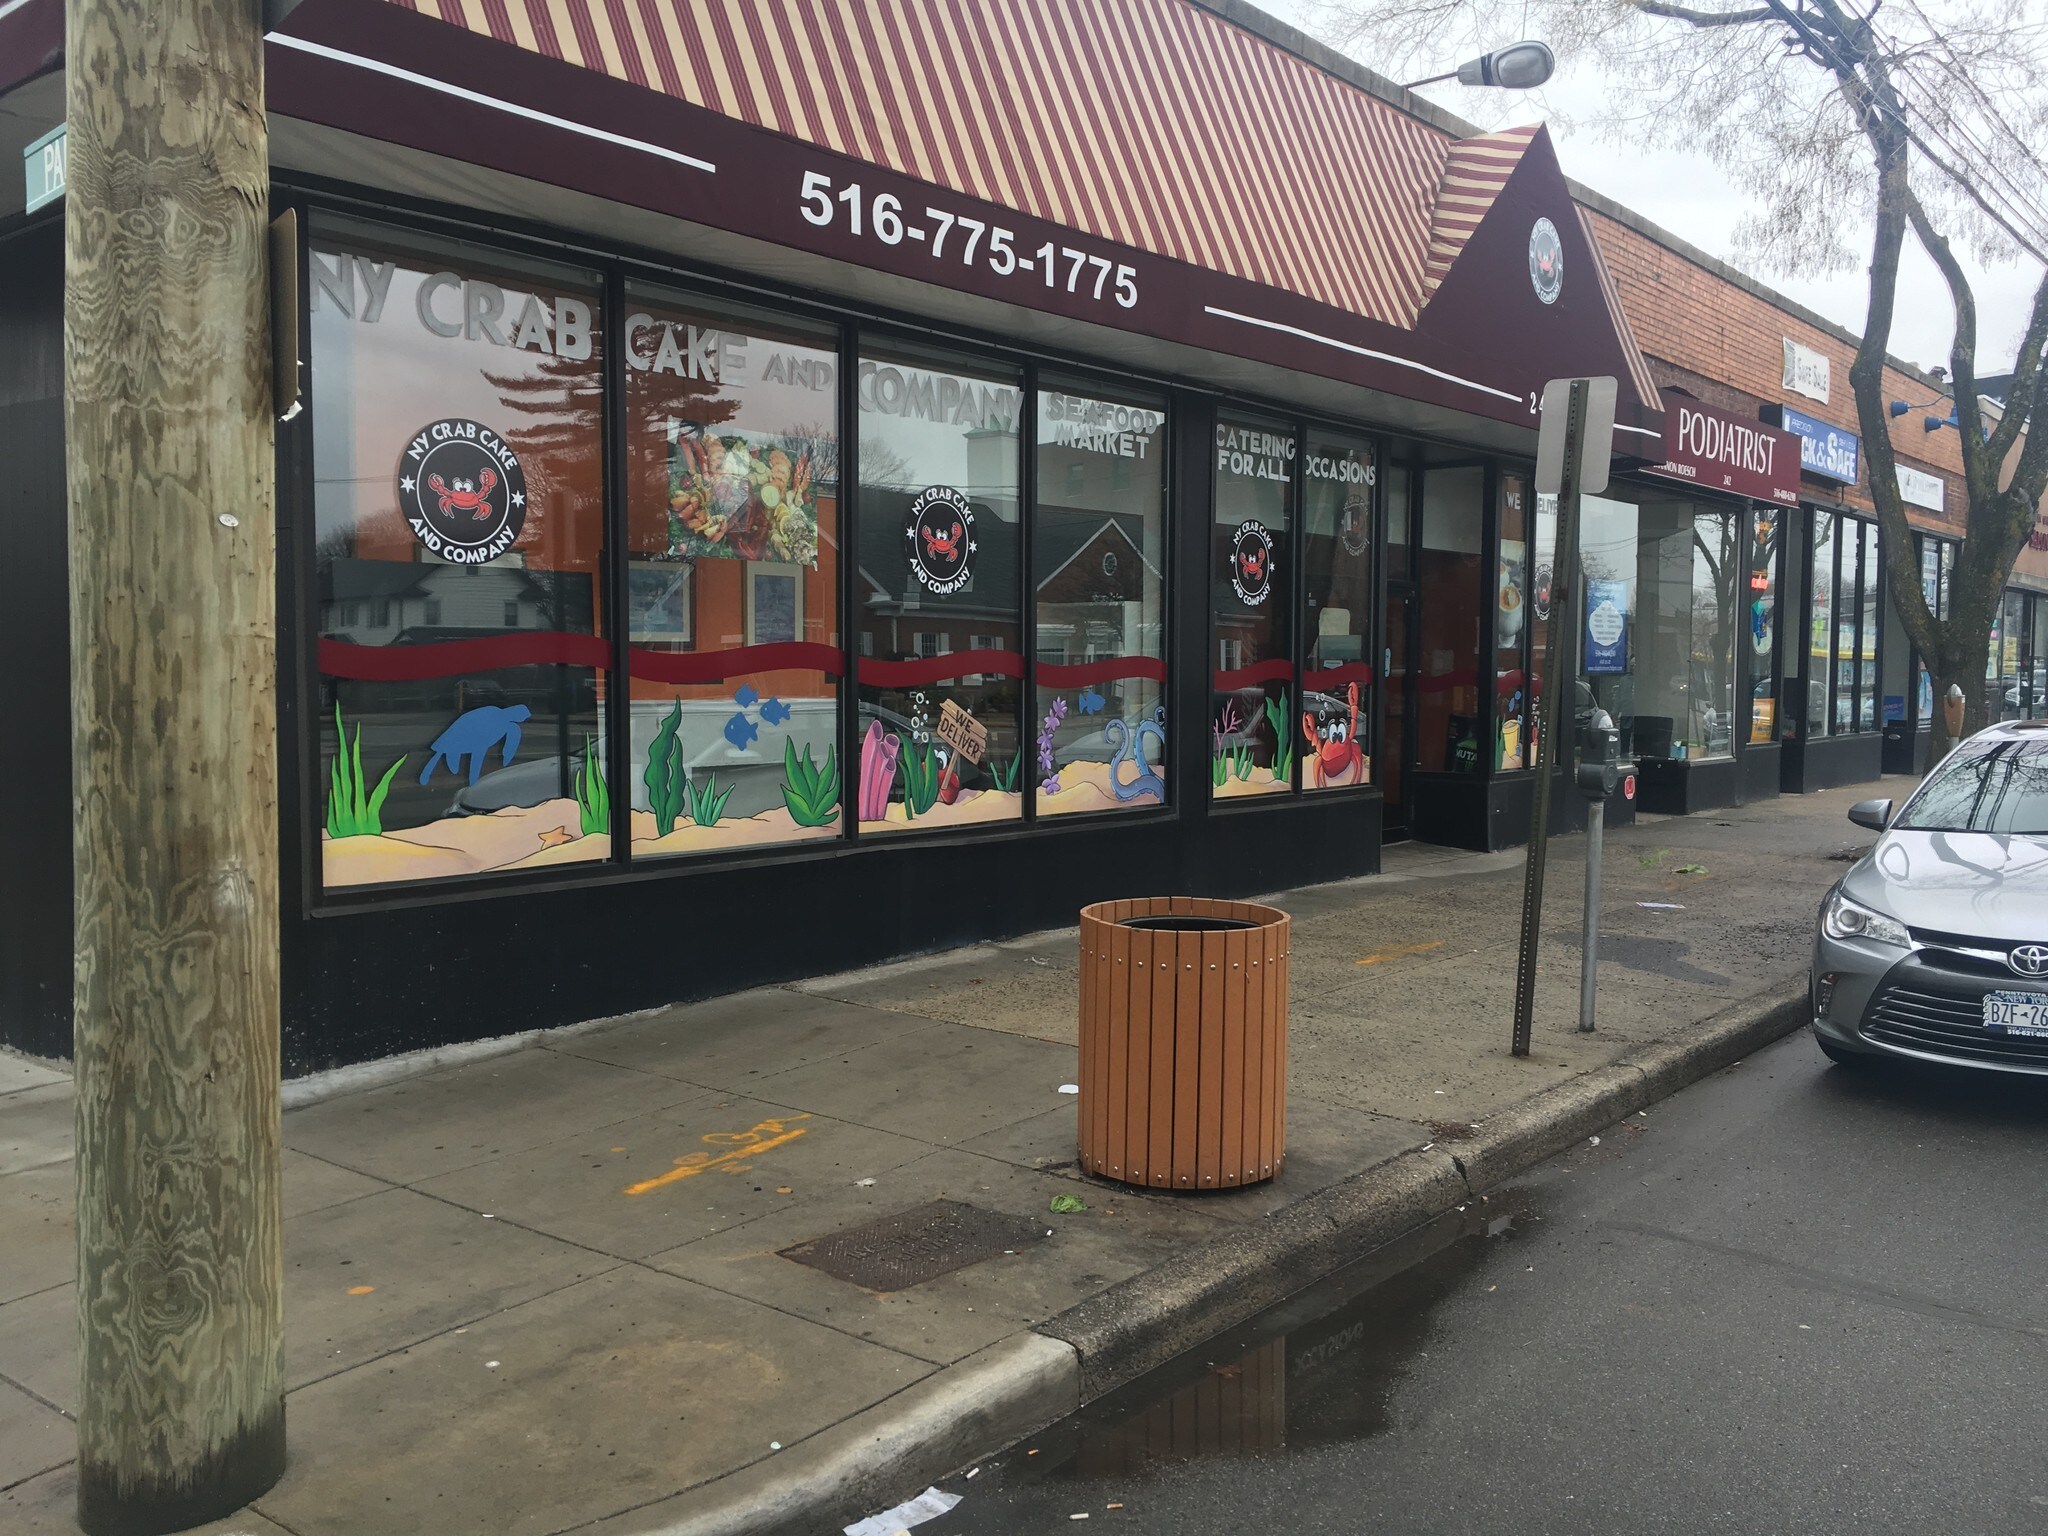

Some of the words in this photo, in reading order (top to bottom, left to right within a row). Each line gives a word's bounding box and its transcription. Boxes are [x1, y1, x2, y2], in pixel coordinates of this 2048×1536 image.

[44, 133, 66, 193] PA
[800, 170, 1138, 308] 516-775-1775
[309, 248, 396, 323] NY
[415, 271, 592, 361] CRAB
[625, 312, 749, 388] CAKE
[761, 352, 834, 392] AND
[858, 361, 1025, 430] COMPANY
[1045, 391, 1158, 435] SEAFOOD
[407, 432, 430, 461] NY
[431, 422, 476, 440] CRAB
[480, 430, 518, 471] CAKE
[1054, 423, 1150, 459] MARKET
[1216, 424, 1296, 461] CATERING
[1678, 407, 1776, 476] PODIATRIST
[1827, 432, 1856, 479] SAFE
[1218, 449, 1255, 477] FOR
[1256, 458, 1290, 482] ALL
[912, 495, 925, 516] NY
[926, 488, 952, 501] CRAB
[953, 494, 975, 525] CAKE
[1506, 491, 1521, 510] WE
[408, 518, 441, 551] AND
[443, 525, 515, 563] COMPANY
[1233, 528, 1241, 545] NY
[1242, 521, 1259, 532] CRAB
[1259, 524, 1274, 550] CAKE
[910, 558, 928, 584] AND
[927, 566, 970, 594] COMPANY
[1231, 578, 1244, 598] AND
[1243, 583, 1271, 606] COMPANY
[940, 718, 980, 759] DELIVER
[956, 710, 974, 733] WE
